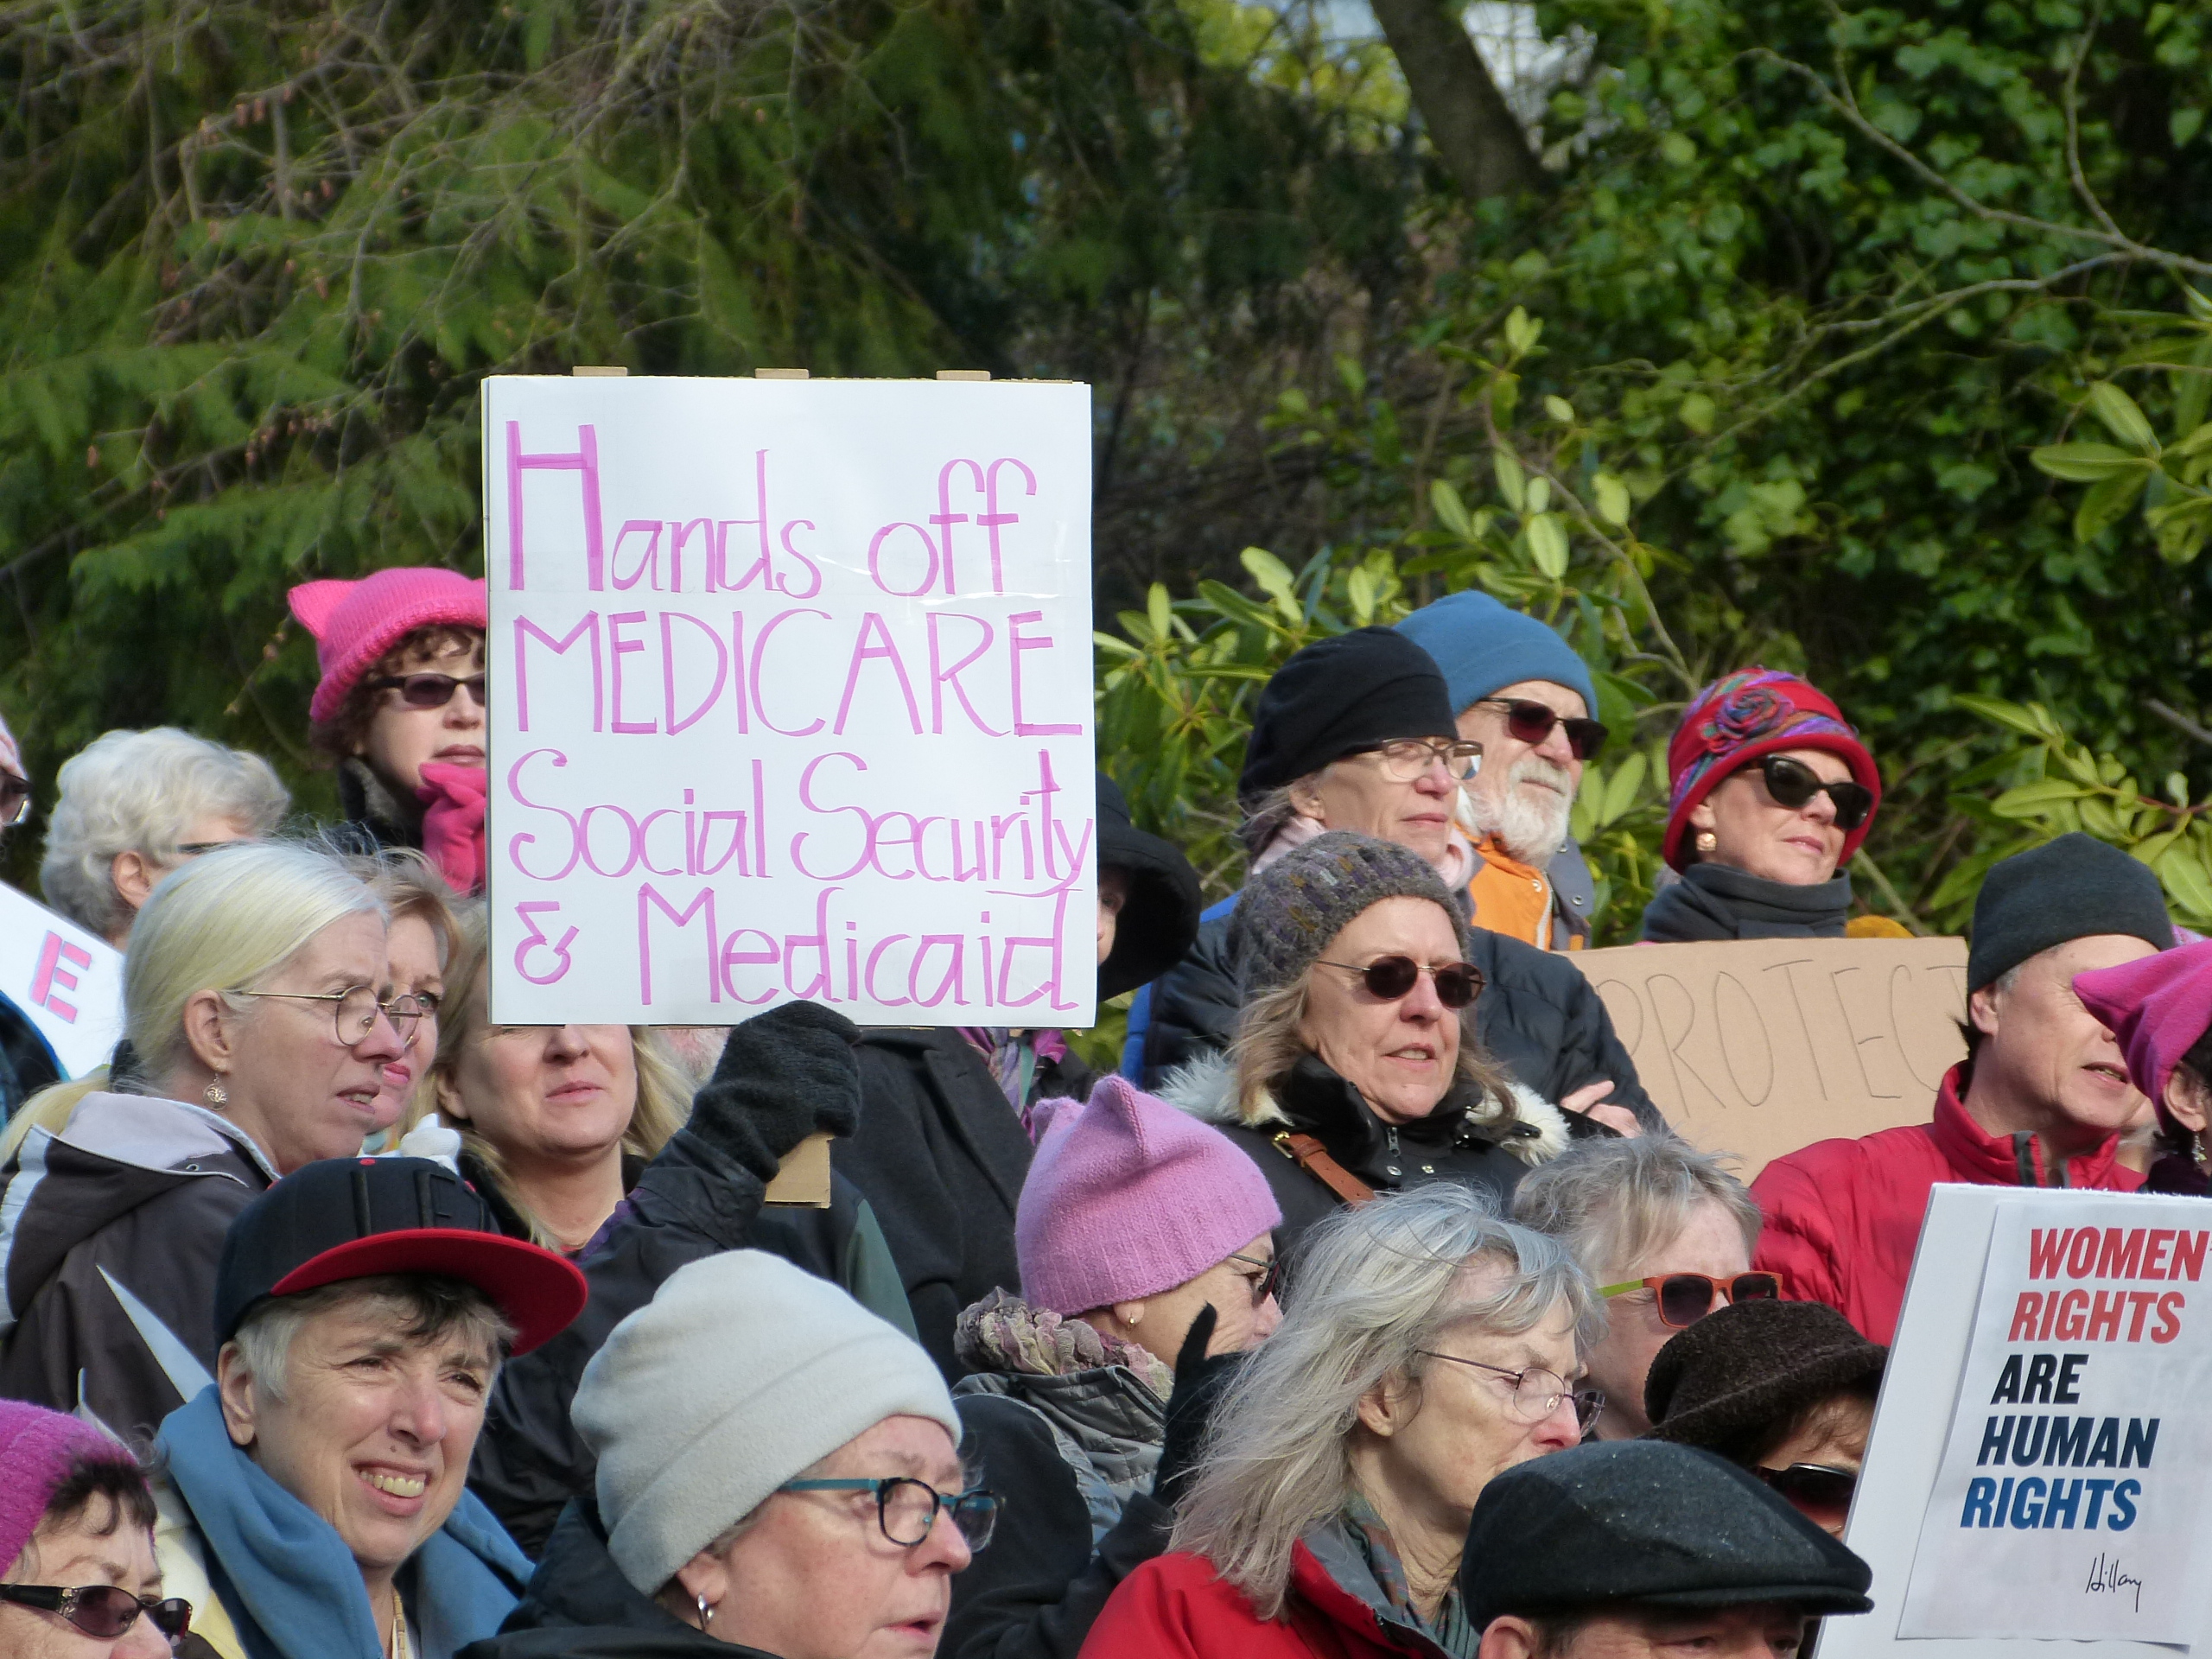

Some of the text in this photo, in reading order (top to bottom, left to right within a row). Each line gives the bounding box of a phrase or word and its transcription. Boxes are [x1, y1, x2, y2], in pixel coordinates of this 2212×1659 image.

[505, 420, 1037, 599] Hands off
[513, 608, 1083, 736] MEDICARE
[507, 748, 1094, 897] Social Security
[513, 882, 1084, 1011] & Medicaid
[2028, 1226, 2212, 1282] WOMEN
[2007, 1288, 2185, 1344] RIGHTS
[1990, 1353, 2089, 1405] ARE
[1975, 1414, 2161, 1469] HUMAN
[1960, 1476, 2142, 1532] RIGHTS
